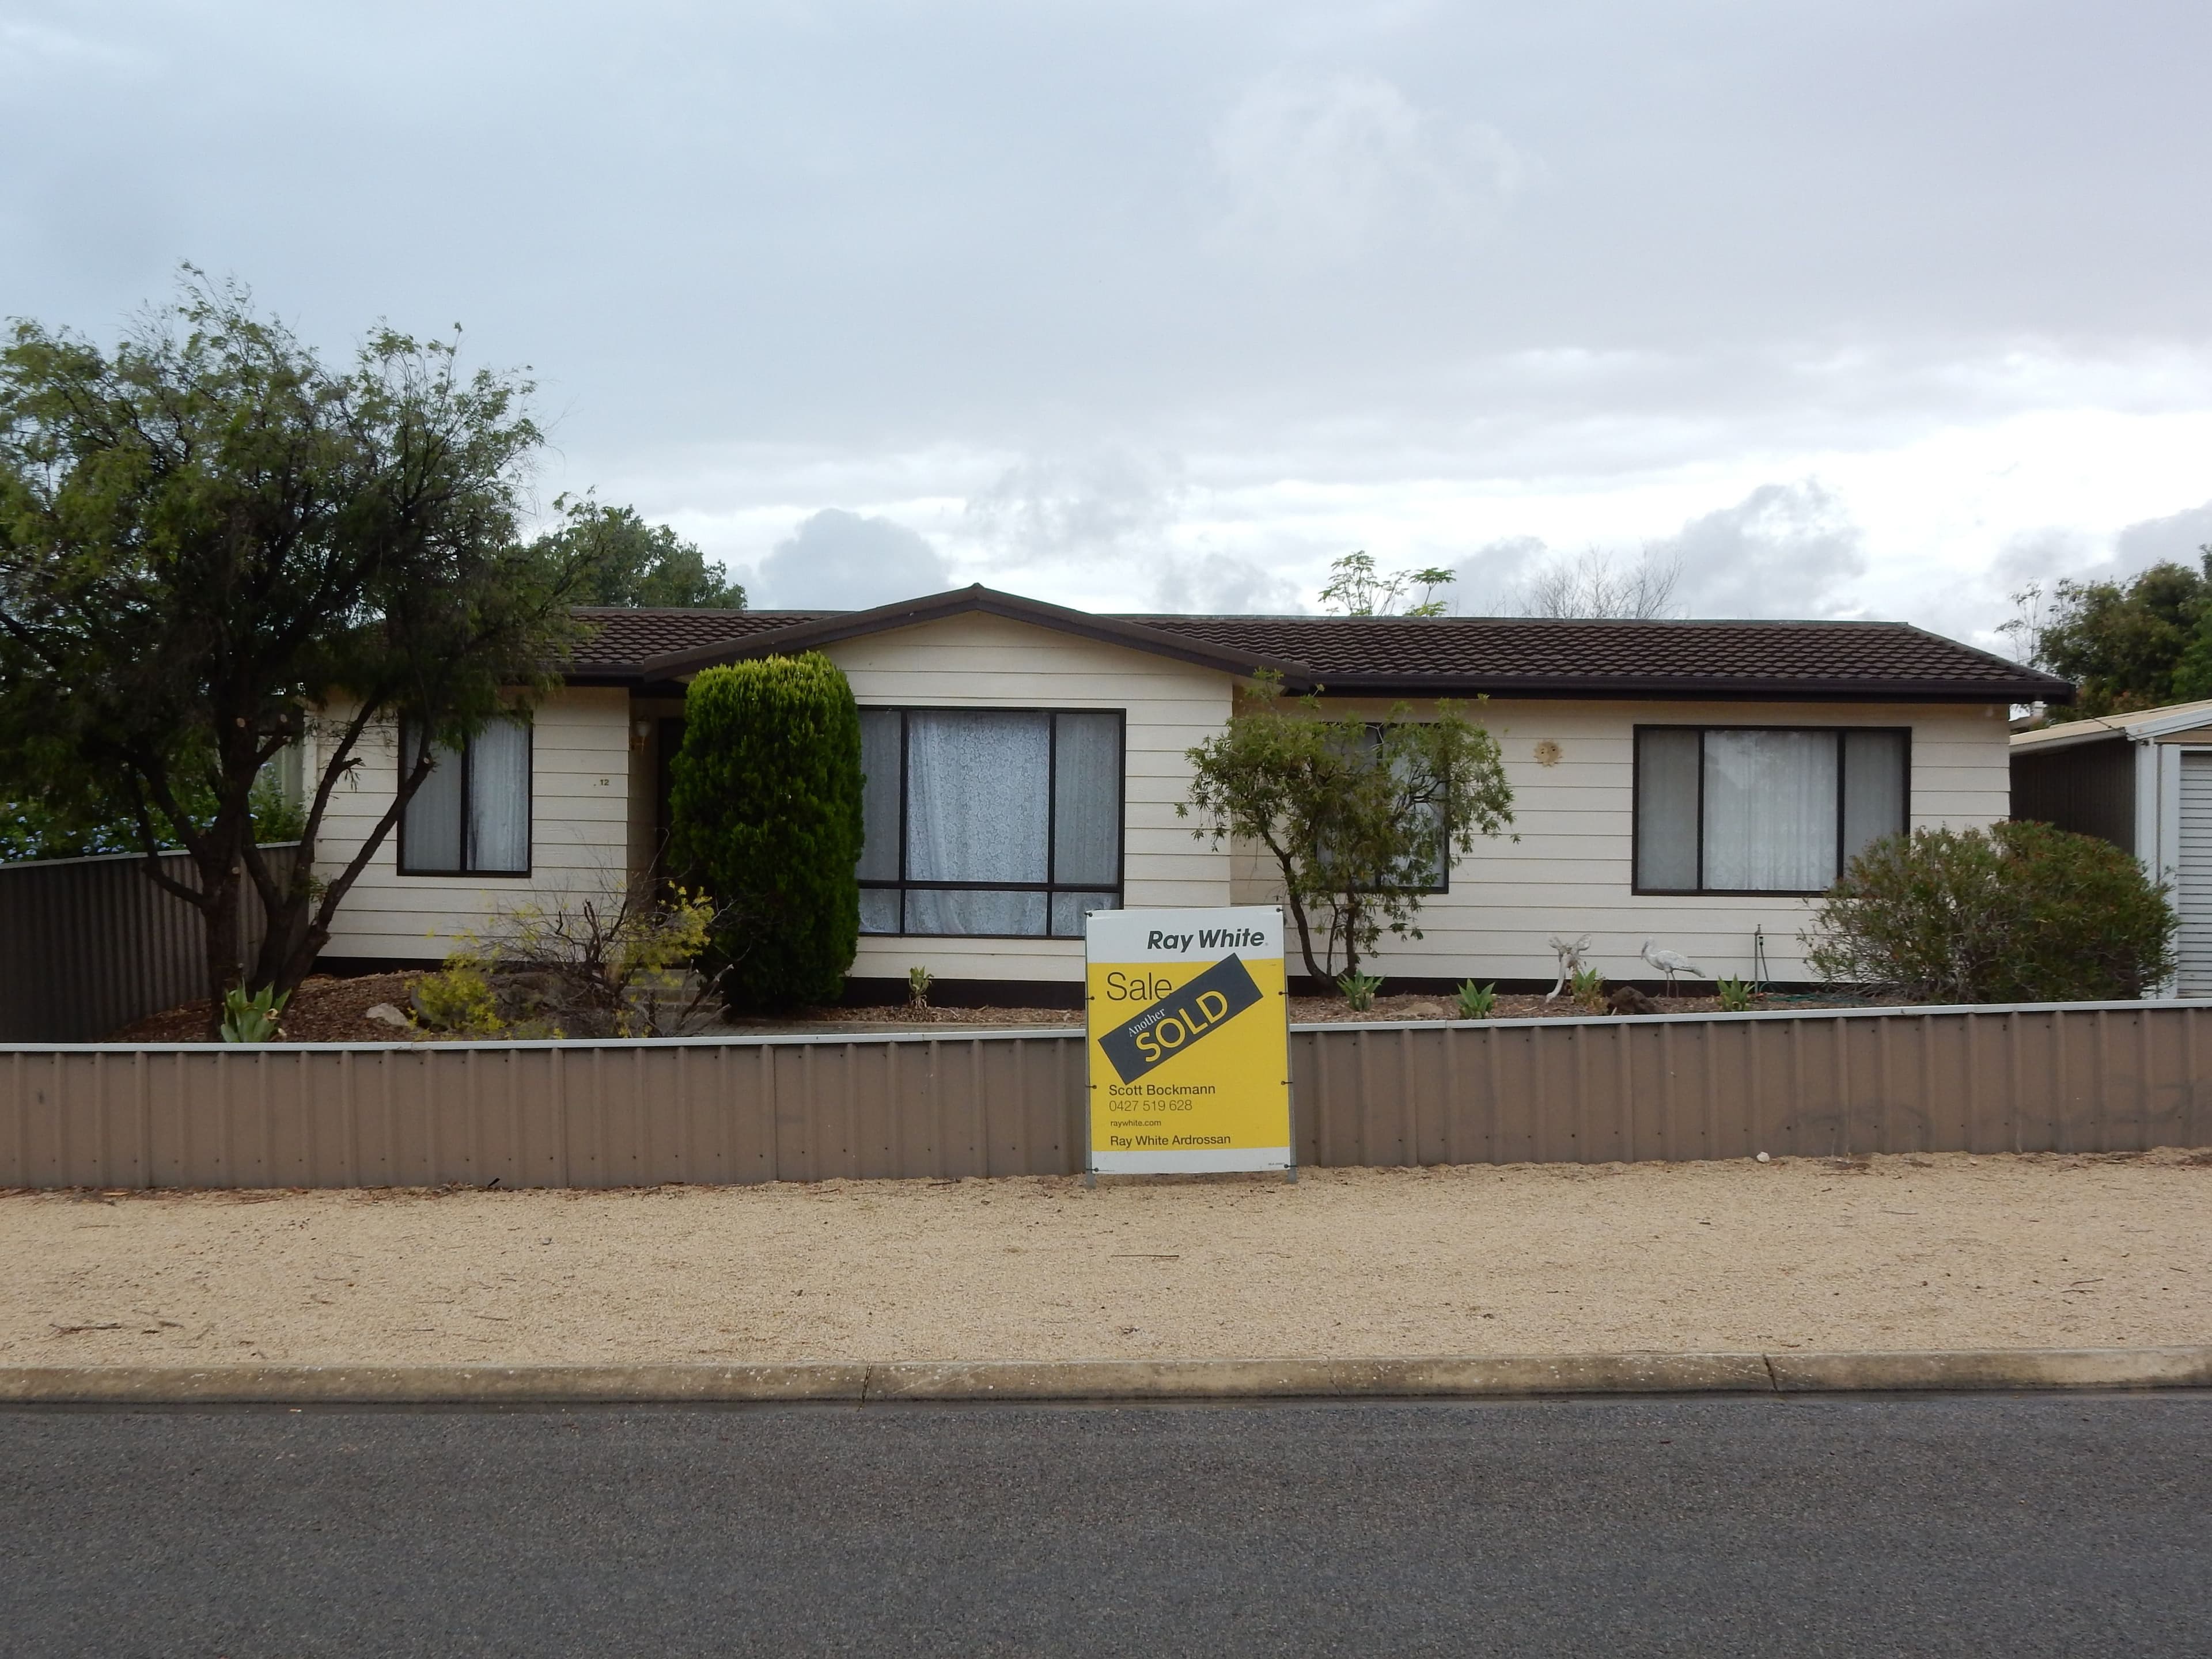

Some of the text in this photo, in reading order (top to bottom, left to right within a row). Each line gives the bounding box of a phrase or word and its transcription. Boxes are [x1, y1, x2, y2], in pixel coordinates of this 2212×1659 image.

[1147, 928, 1264, 952] Ray White
[1107, 972, 1172, 1001] Sale
[1128, 1007, 1166, 1037] Another
[1135, 990, 1228, 1062] SOLD
[1109, 1084, 1215, 1096] Scott Bockmann
[1109, 1100, 1192, 1111] 0427 519 628
[1110, 1119, 1161, 1128] raywhite.com
[1110, 1134, 1231, 1148] Ray White Ardrossan
